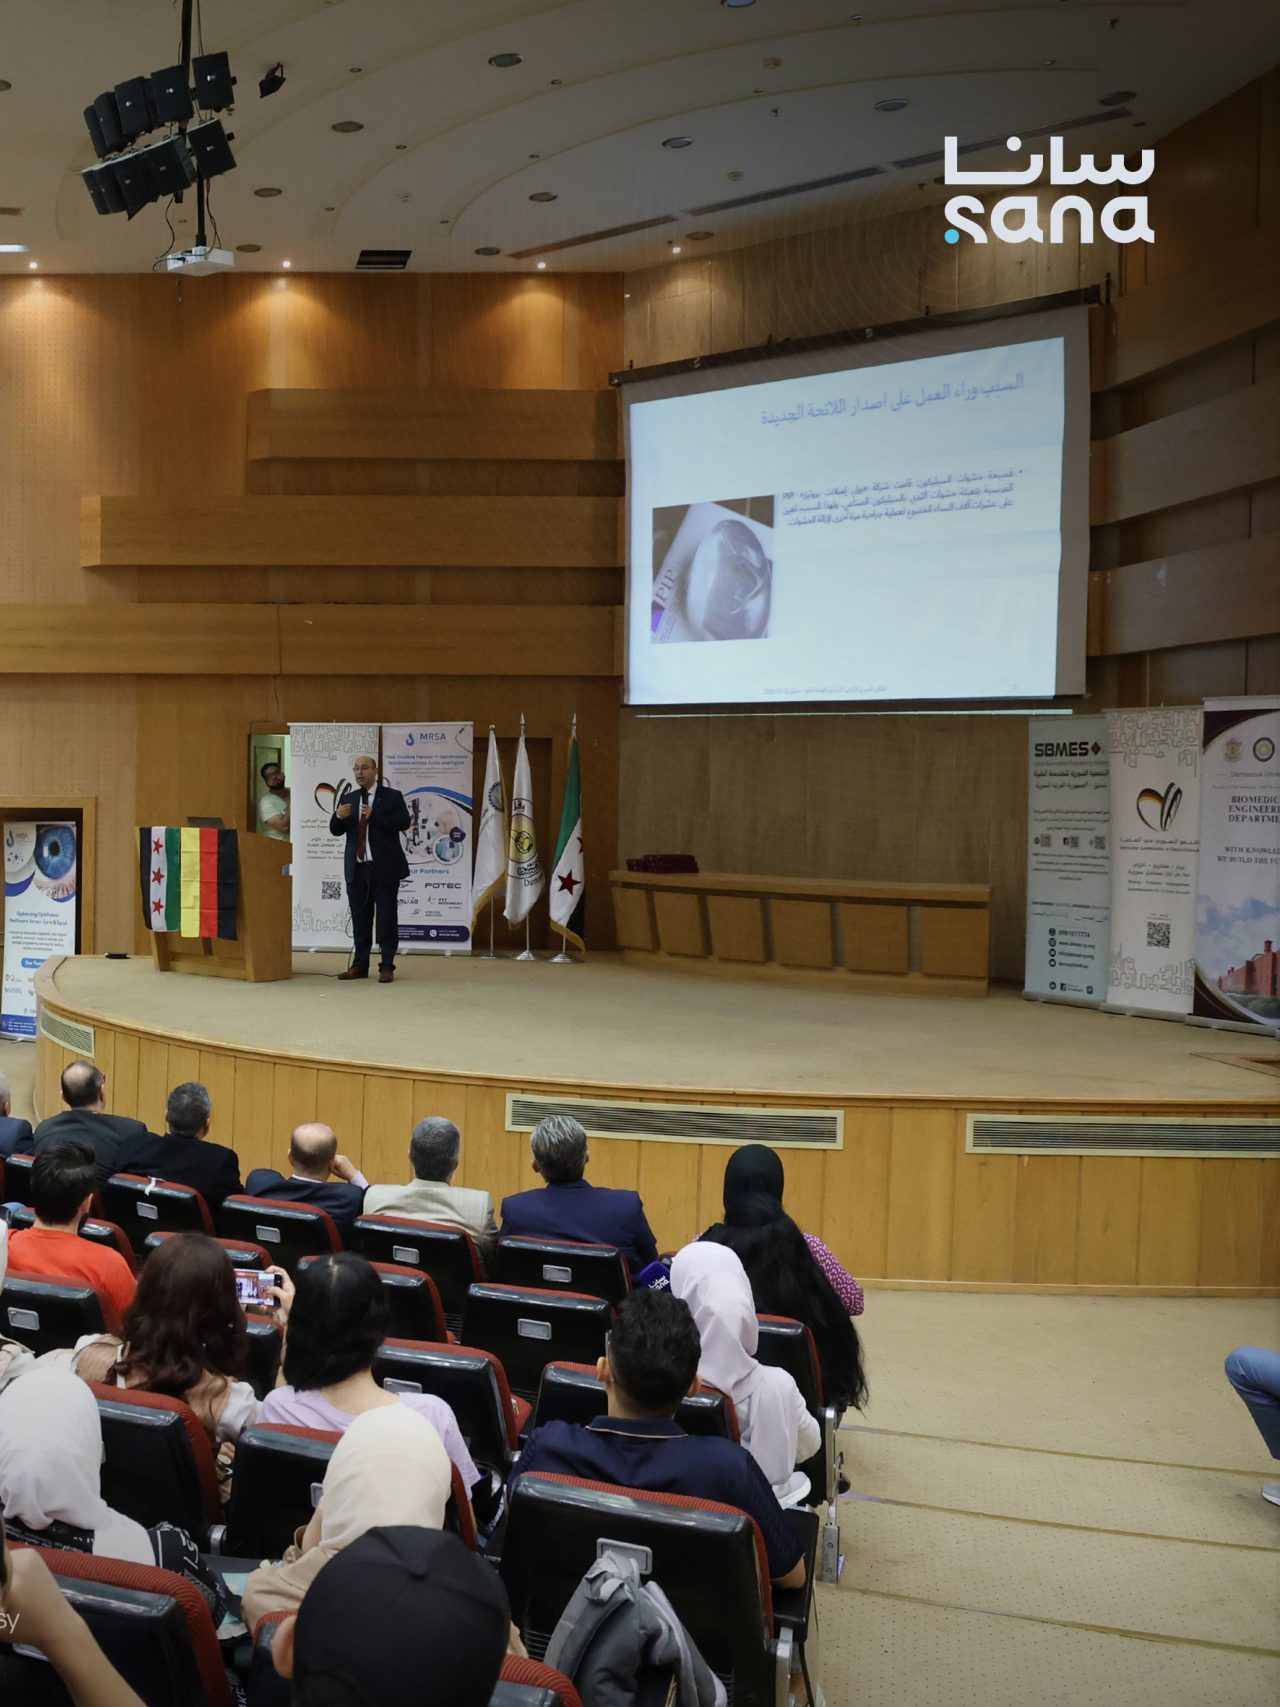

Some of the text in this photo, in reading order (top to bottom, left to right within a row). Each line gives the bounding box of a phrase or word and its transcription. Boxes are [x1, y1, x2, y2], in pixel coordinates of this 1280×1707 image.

[915, 383, 951, 407] العمل
[954, 381, 978, 402] وراء
[981, 372, 1024, 399] السبب
[890, 389, 912, 411] على
[761, 403, 804, 426] الجديدة
[419, 732, 447, 741] MRSA
[1034, 741, 1089, 758] SBMES
